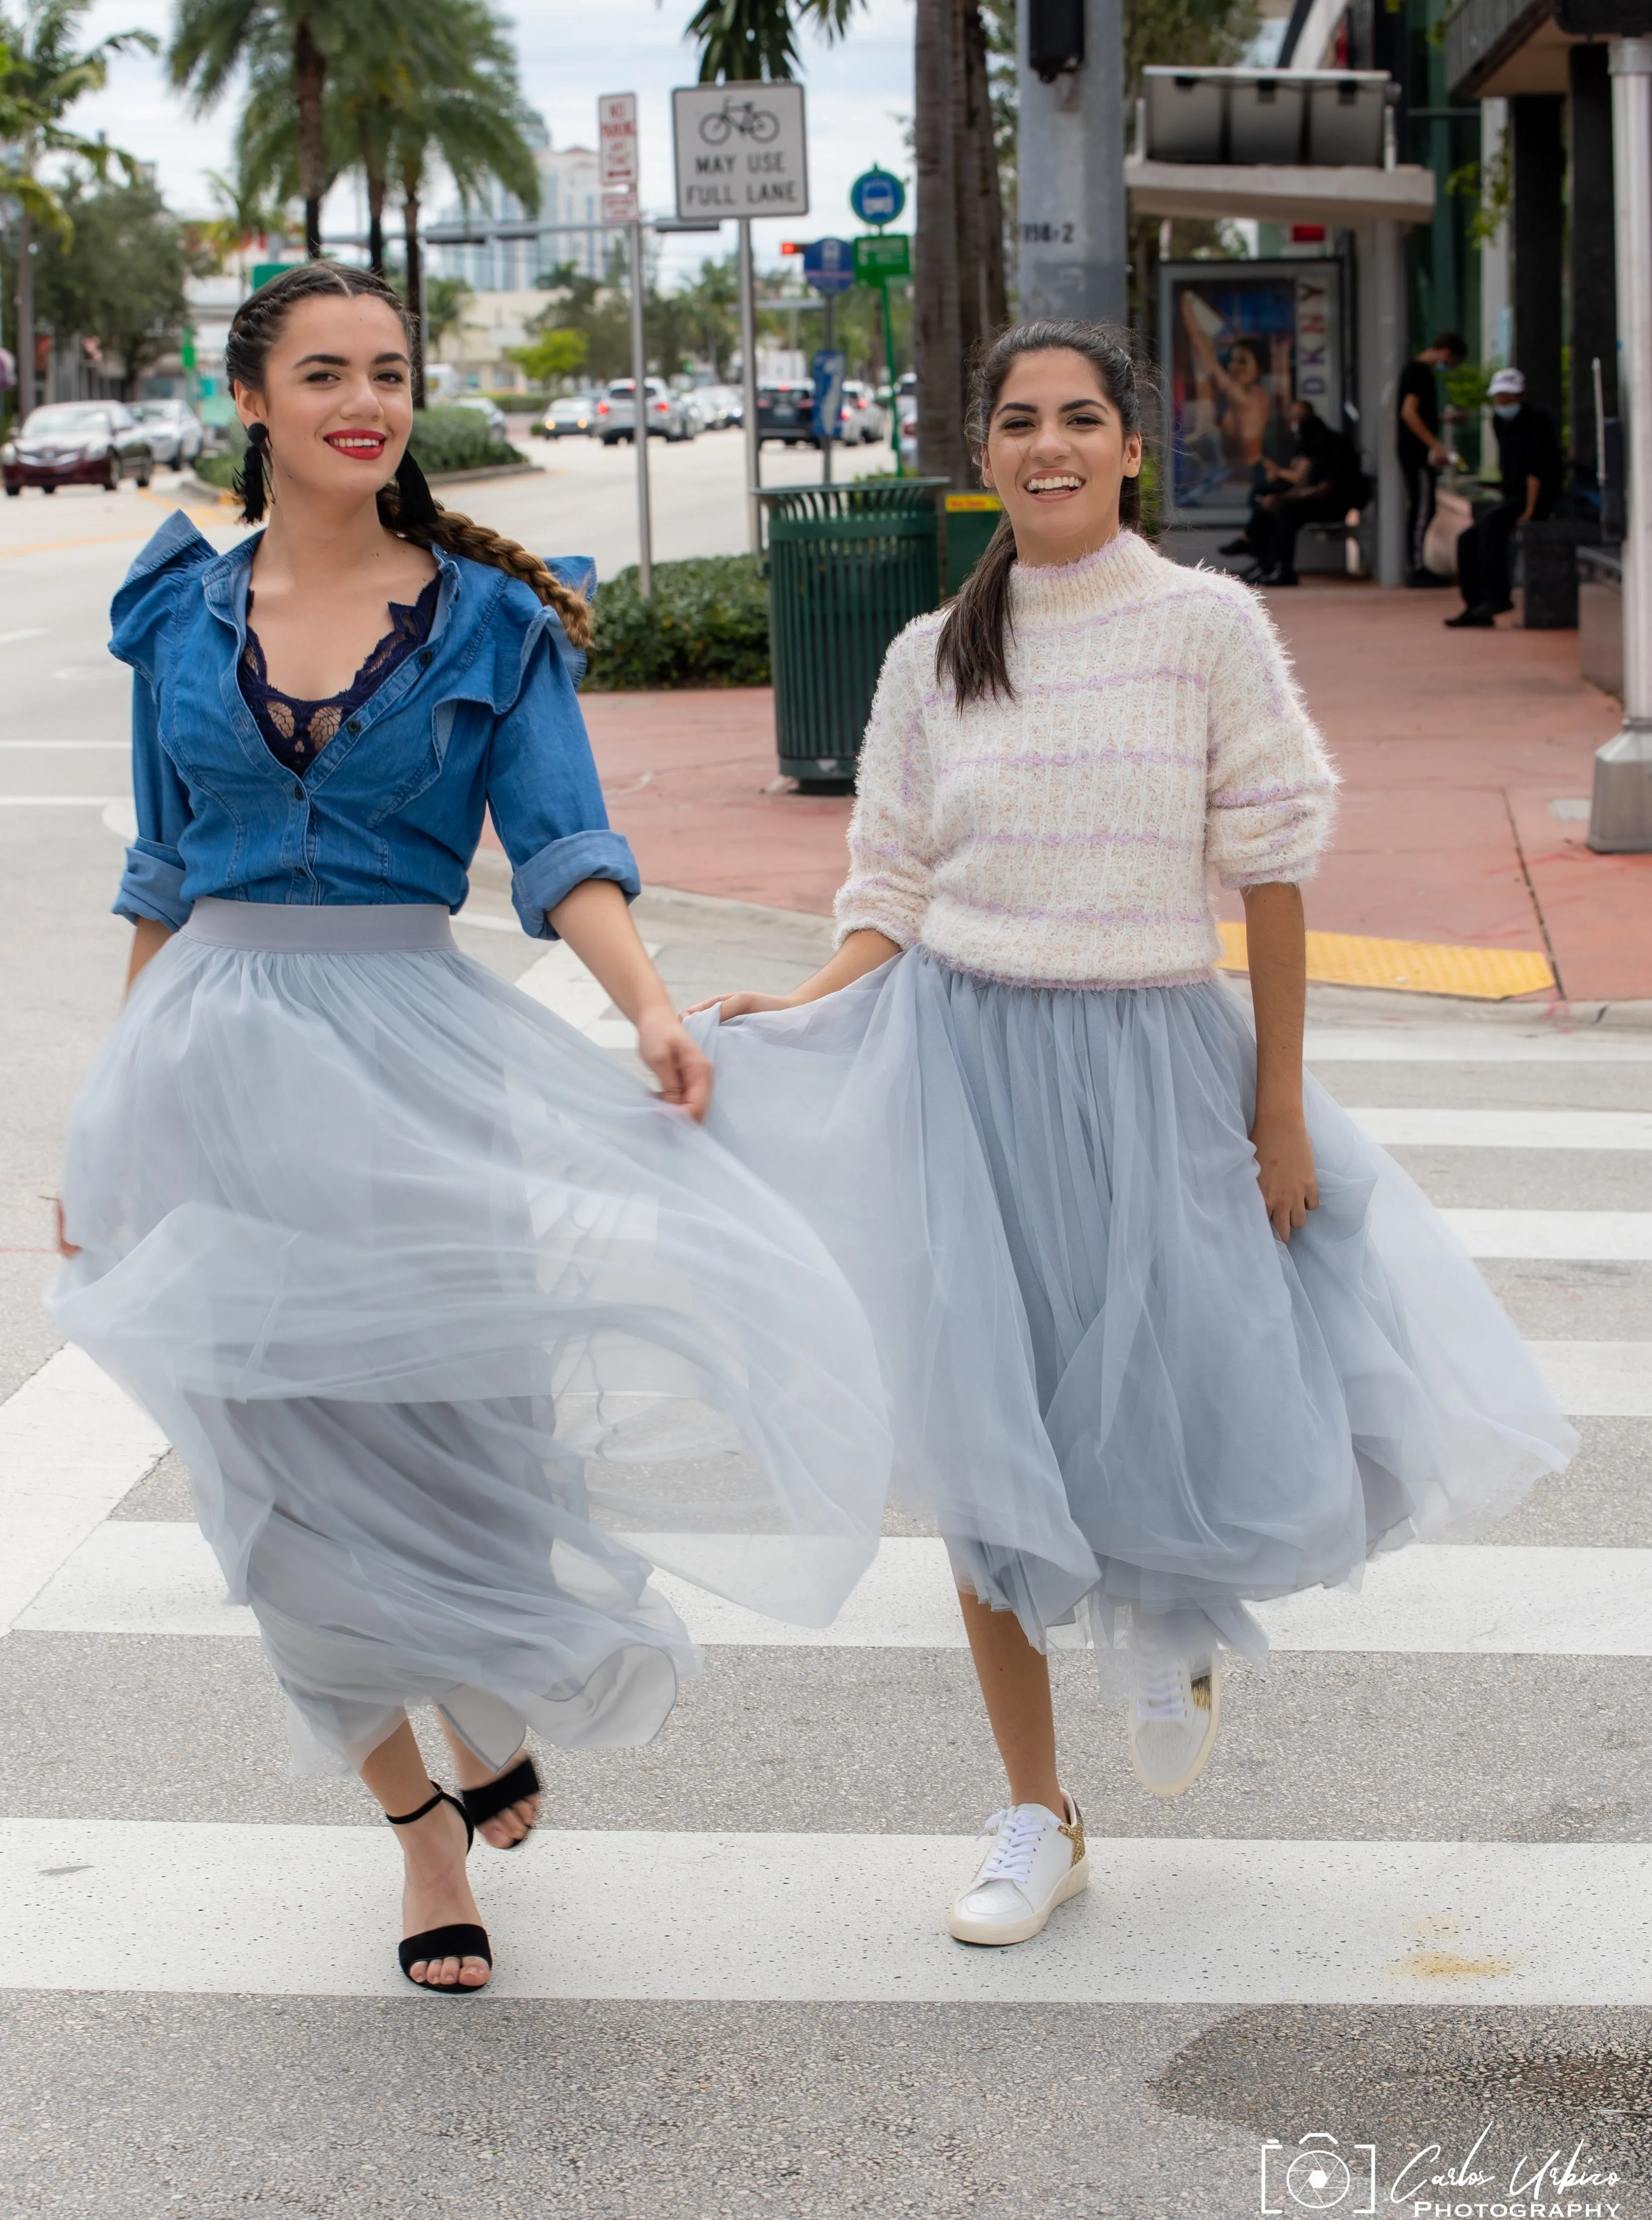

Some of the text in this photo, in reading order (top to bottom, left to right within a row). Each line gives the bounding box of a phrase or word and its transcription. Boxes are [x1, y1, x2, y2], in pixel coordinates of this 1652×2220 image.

[695, 150, 785, 175] MAY USE
[686, 180, 797, 207] FULL LANE
[1300, 283, 1327, 395] DKNY
